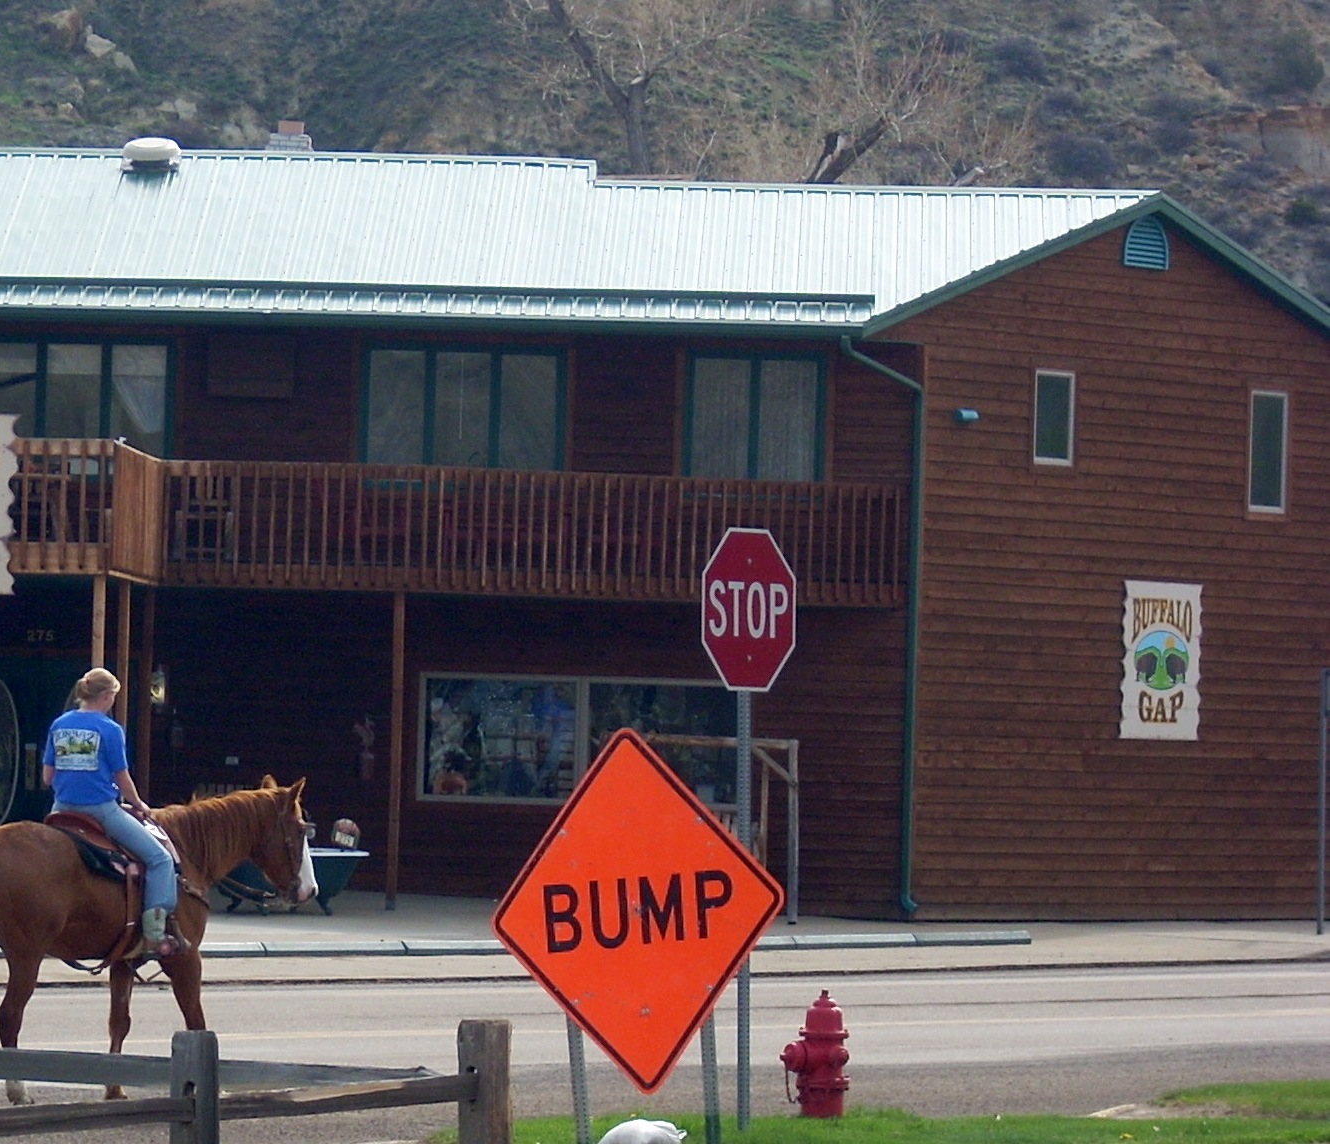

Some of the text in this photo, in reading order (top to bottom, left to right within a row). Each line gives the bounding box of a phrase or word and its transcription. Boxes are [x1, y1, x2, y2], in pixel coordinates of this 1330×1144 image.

[709, 579, 789, 639] STOP
[1132, 598, 1192, 643] BUFFALO
[27, 629, 56, 641] 275
[1138, 690, 1184, 723] GAP
[543, 870, 732, 954] BUMP
